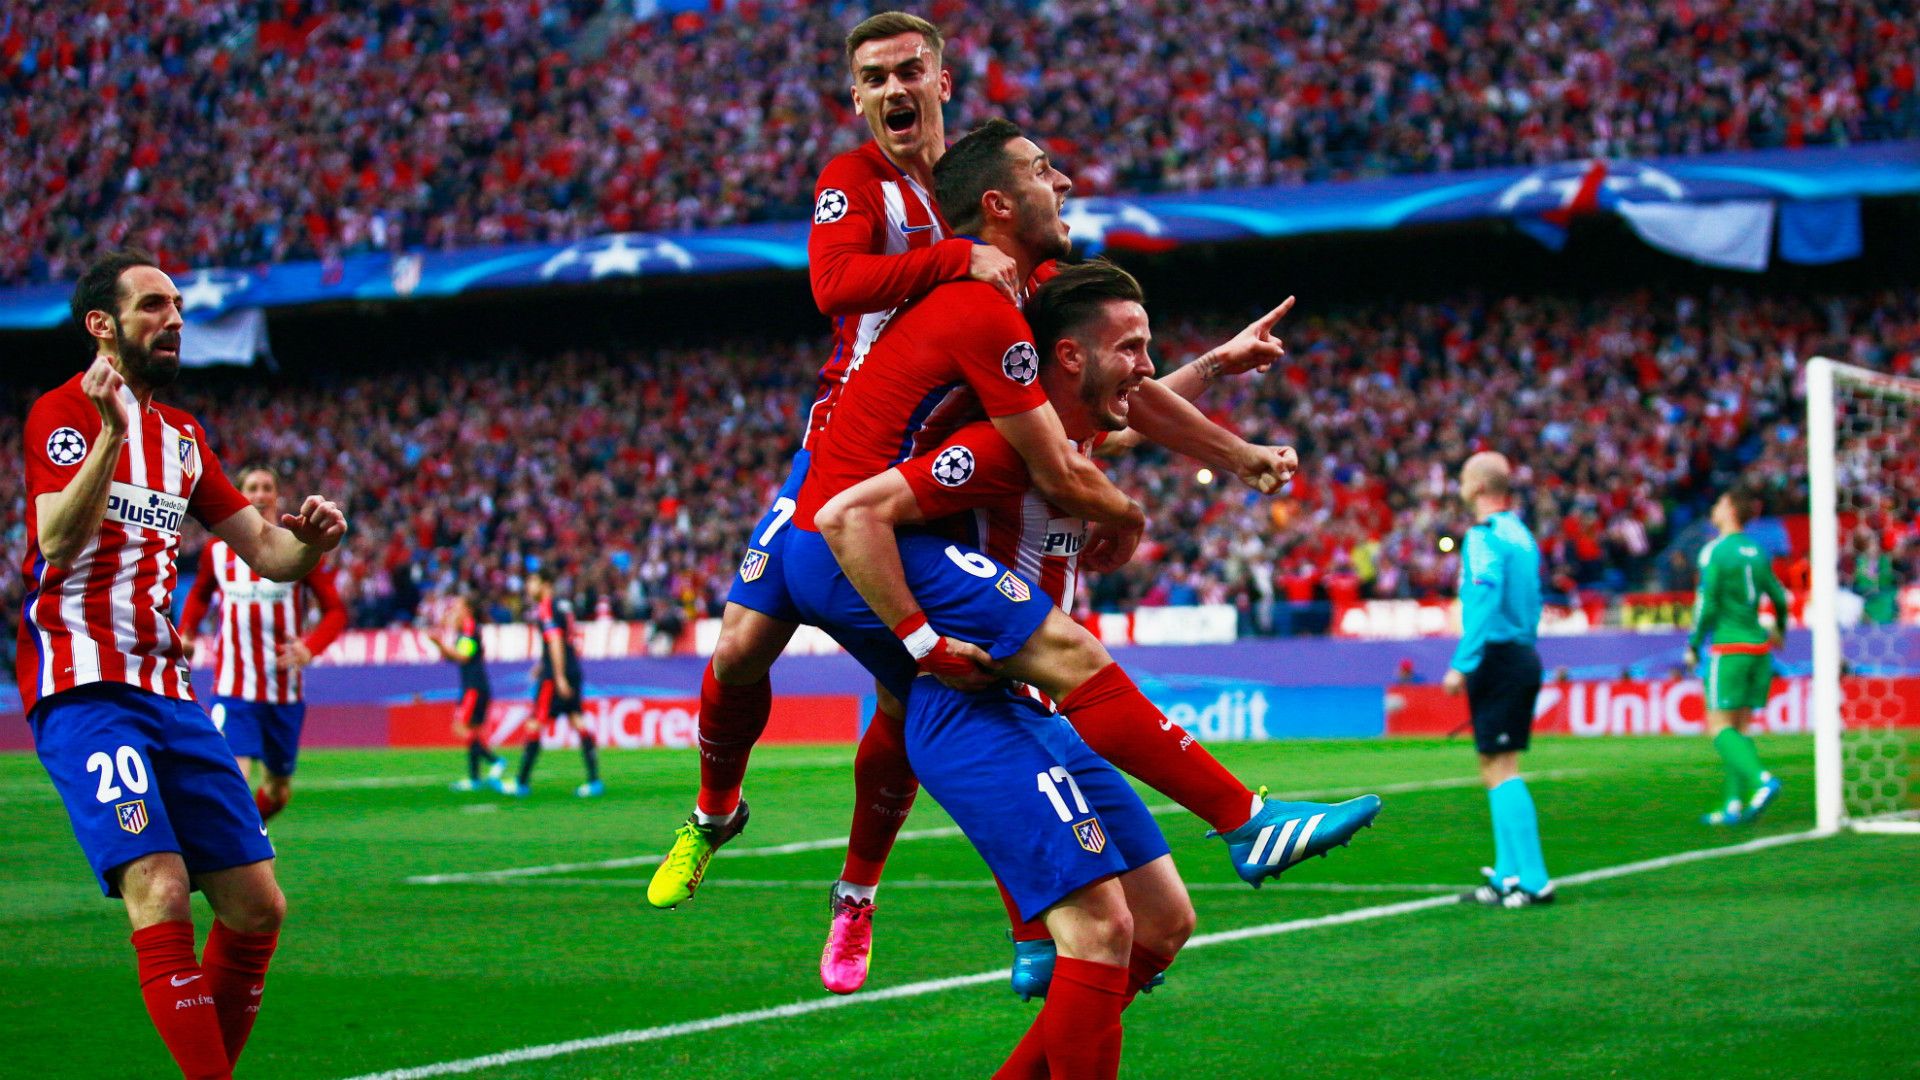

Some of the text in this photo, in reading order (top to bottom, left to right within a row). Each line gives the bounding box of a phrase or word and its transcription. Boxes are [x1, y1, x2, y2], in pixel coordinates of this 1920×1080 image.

[160, 498, 176, 509] Trade
[758, 496, 796, 547] 7
[944, 545, 997, 578] 6
[1157, 690, 1268, 742] edit
[86, 745, 148, 804] 20
[1037, 766, 1090, 822] 17
